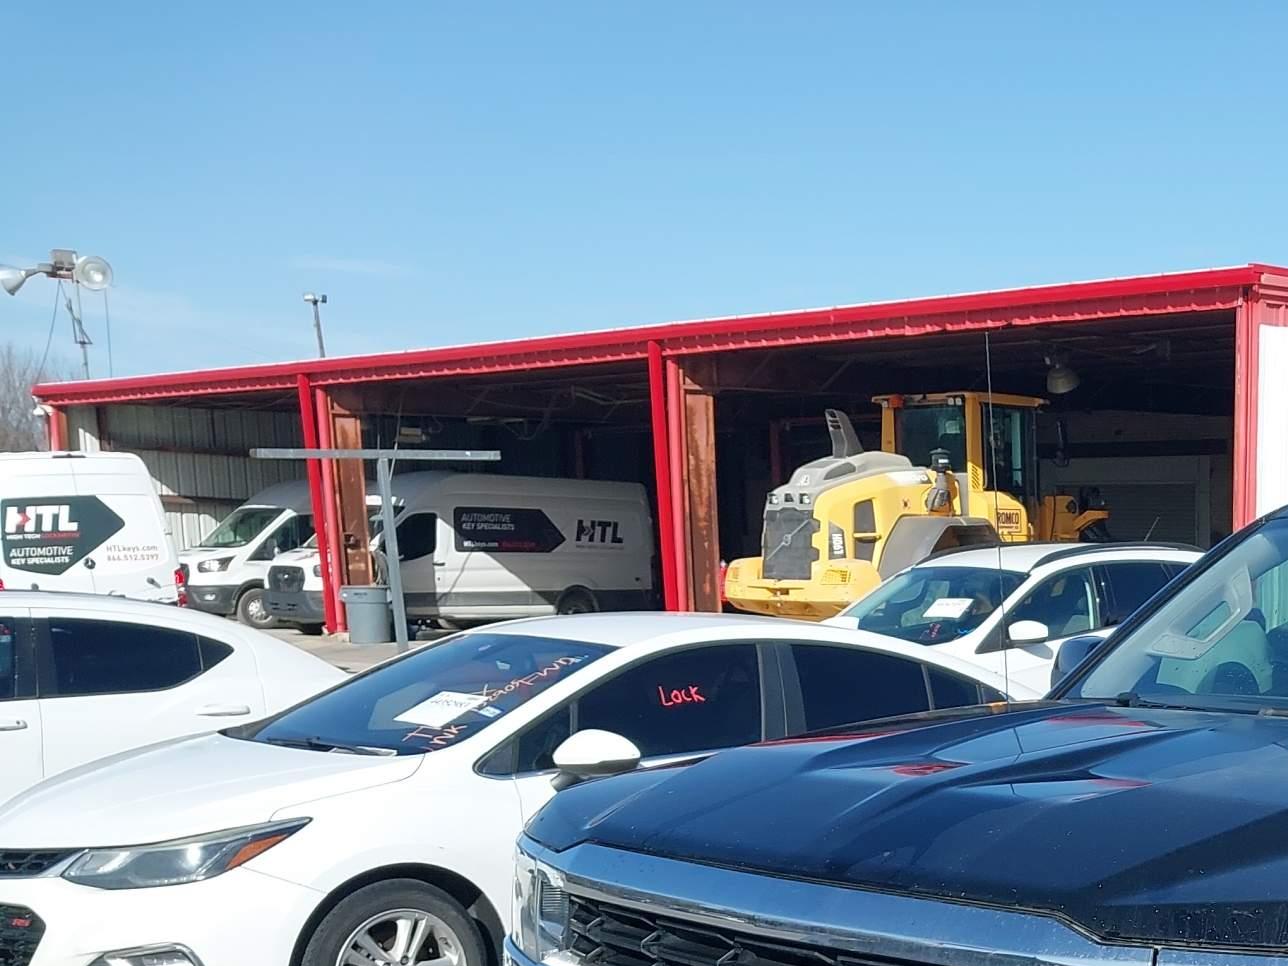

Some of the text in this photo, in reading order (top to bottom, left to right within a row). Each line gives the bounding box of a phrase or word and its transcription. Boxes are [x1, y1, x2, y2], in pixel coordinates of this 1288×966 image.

[5, 505, 79, 534] HTL
[461, 512, 512, 523] AUTOMOTIVE
[576, 519, 624, 544] HTL
[9, 545, 75, 558] AUTOMOTIVE
[11, 555, 71, 566] KEY SPECIALISTS
